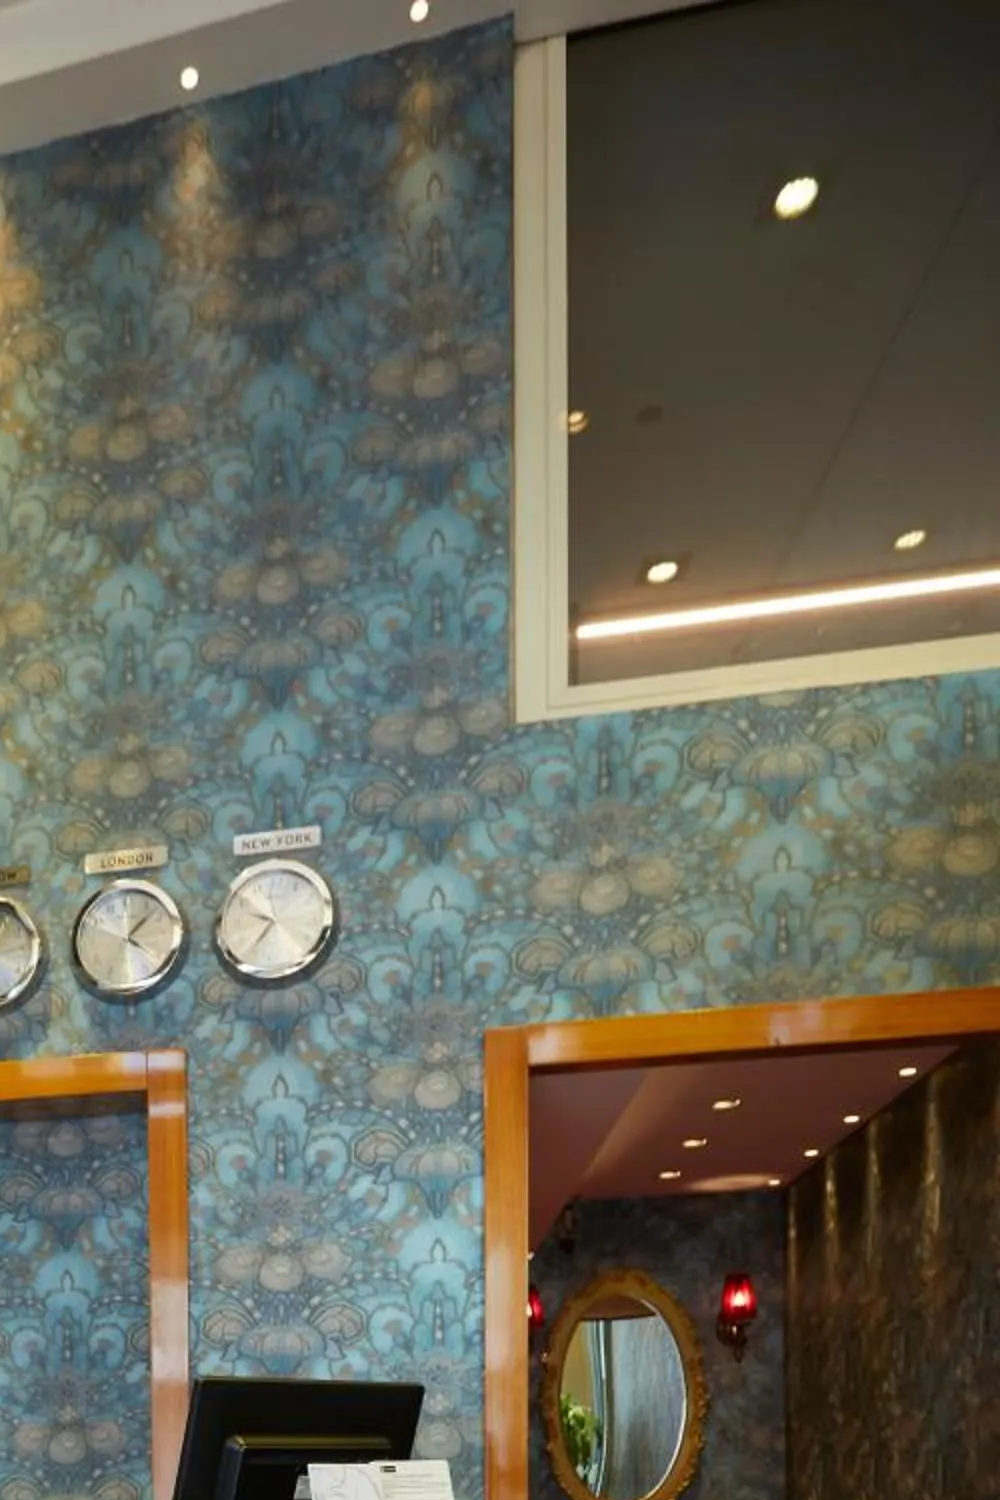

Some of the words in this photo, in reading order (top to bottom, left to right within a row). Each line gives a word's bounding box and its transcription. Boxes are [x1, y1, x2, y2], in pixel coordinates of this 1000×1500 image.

[242, 837, 270, 851] NEW
[277, 832, 313, 847] YORK
[100, 851, 154, 868] LONDON
